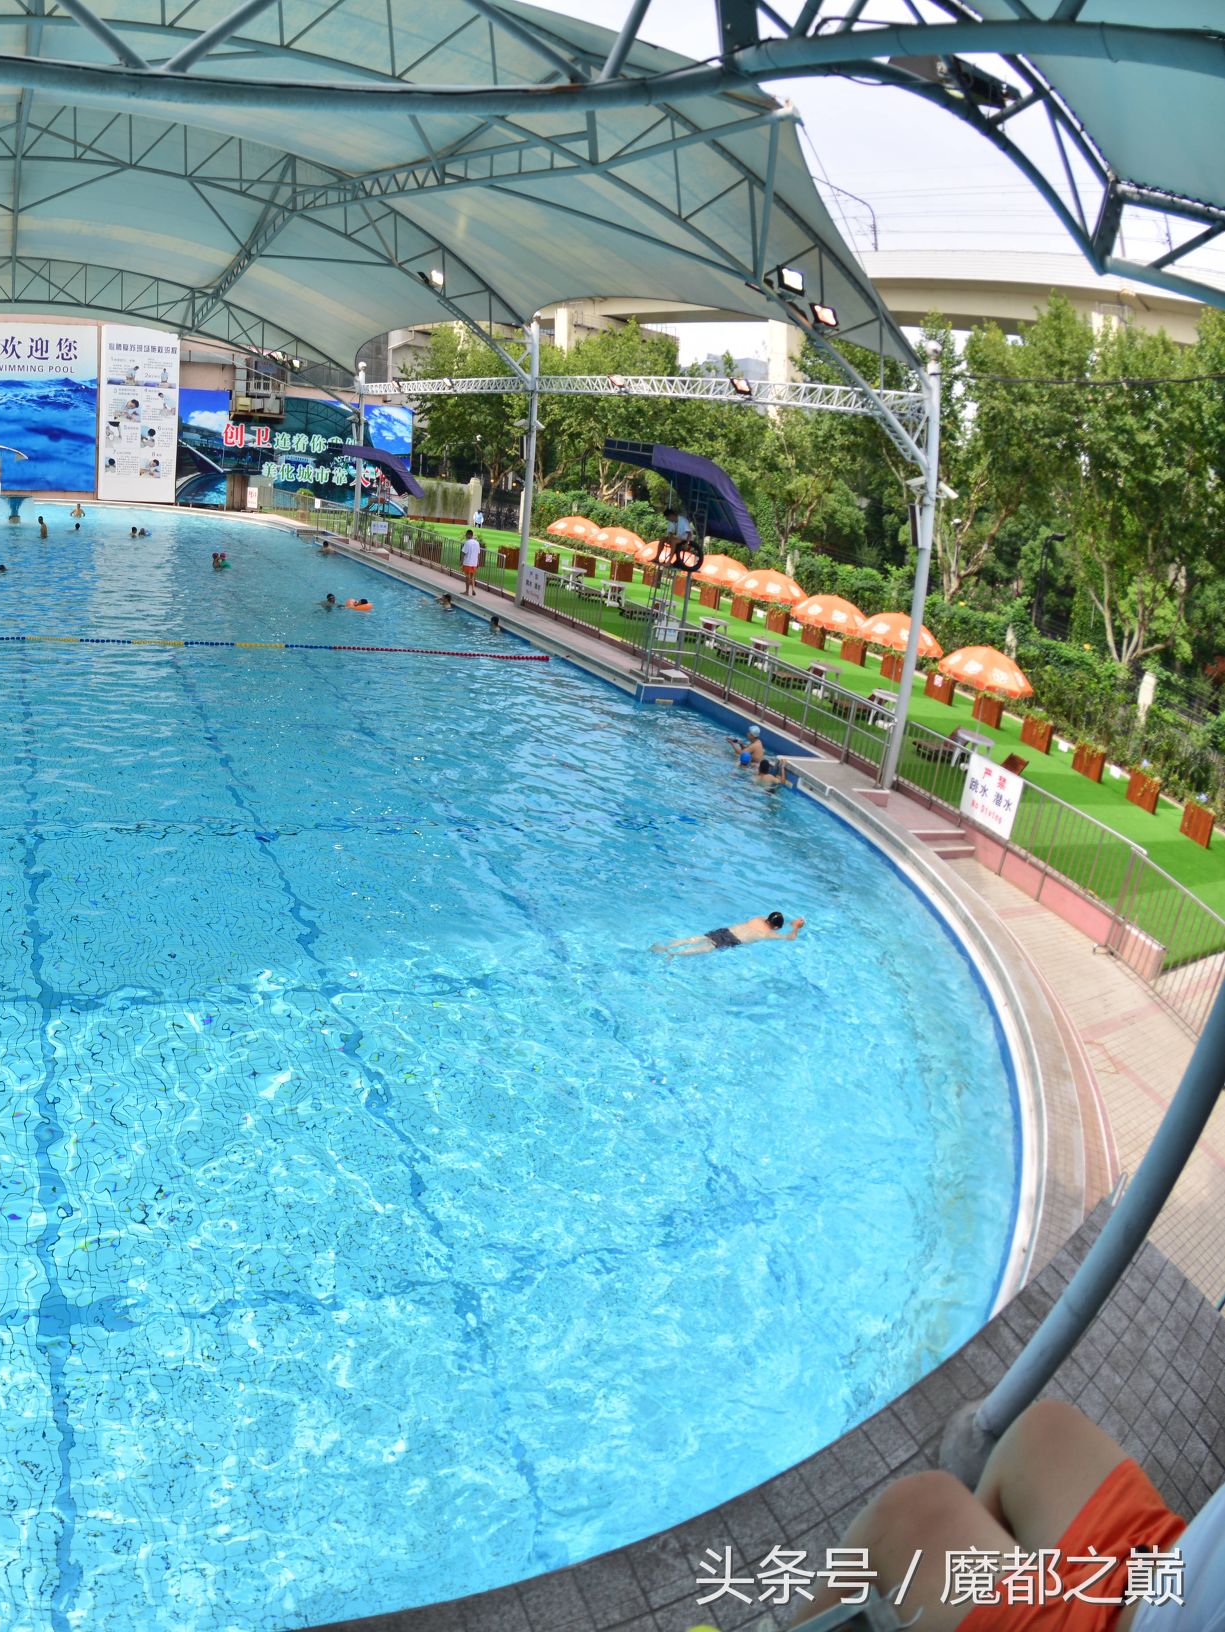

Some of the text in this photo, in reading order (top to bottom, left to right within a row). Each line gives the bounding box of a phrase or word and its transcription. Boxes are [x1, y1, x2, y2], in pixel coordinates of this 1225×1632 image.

[48, 365, 76, 373] POOL
[222, 423, 359, 453] 创卫连着你
[982, 767, 1007, 791] 严禁
[969, 777, 1013, 812] 跳水 潜水
